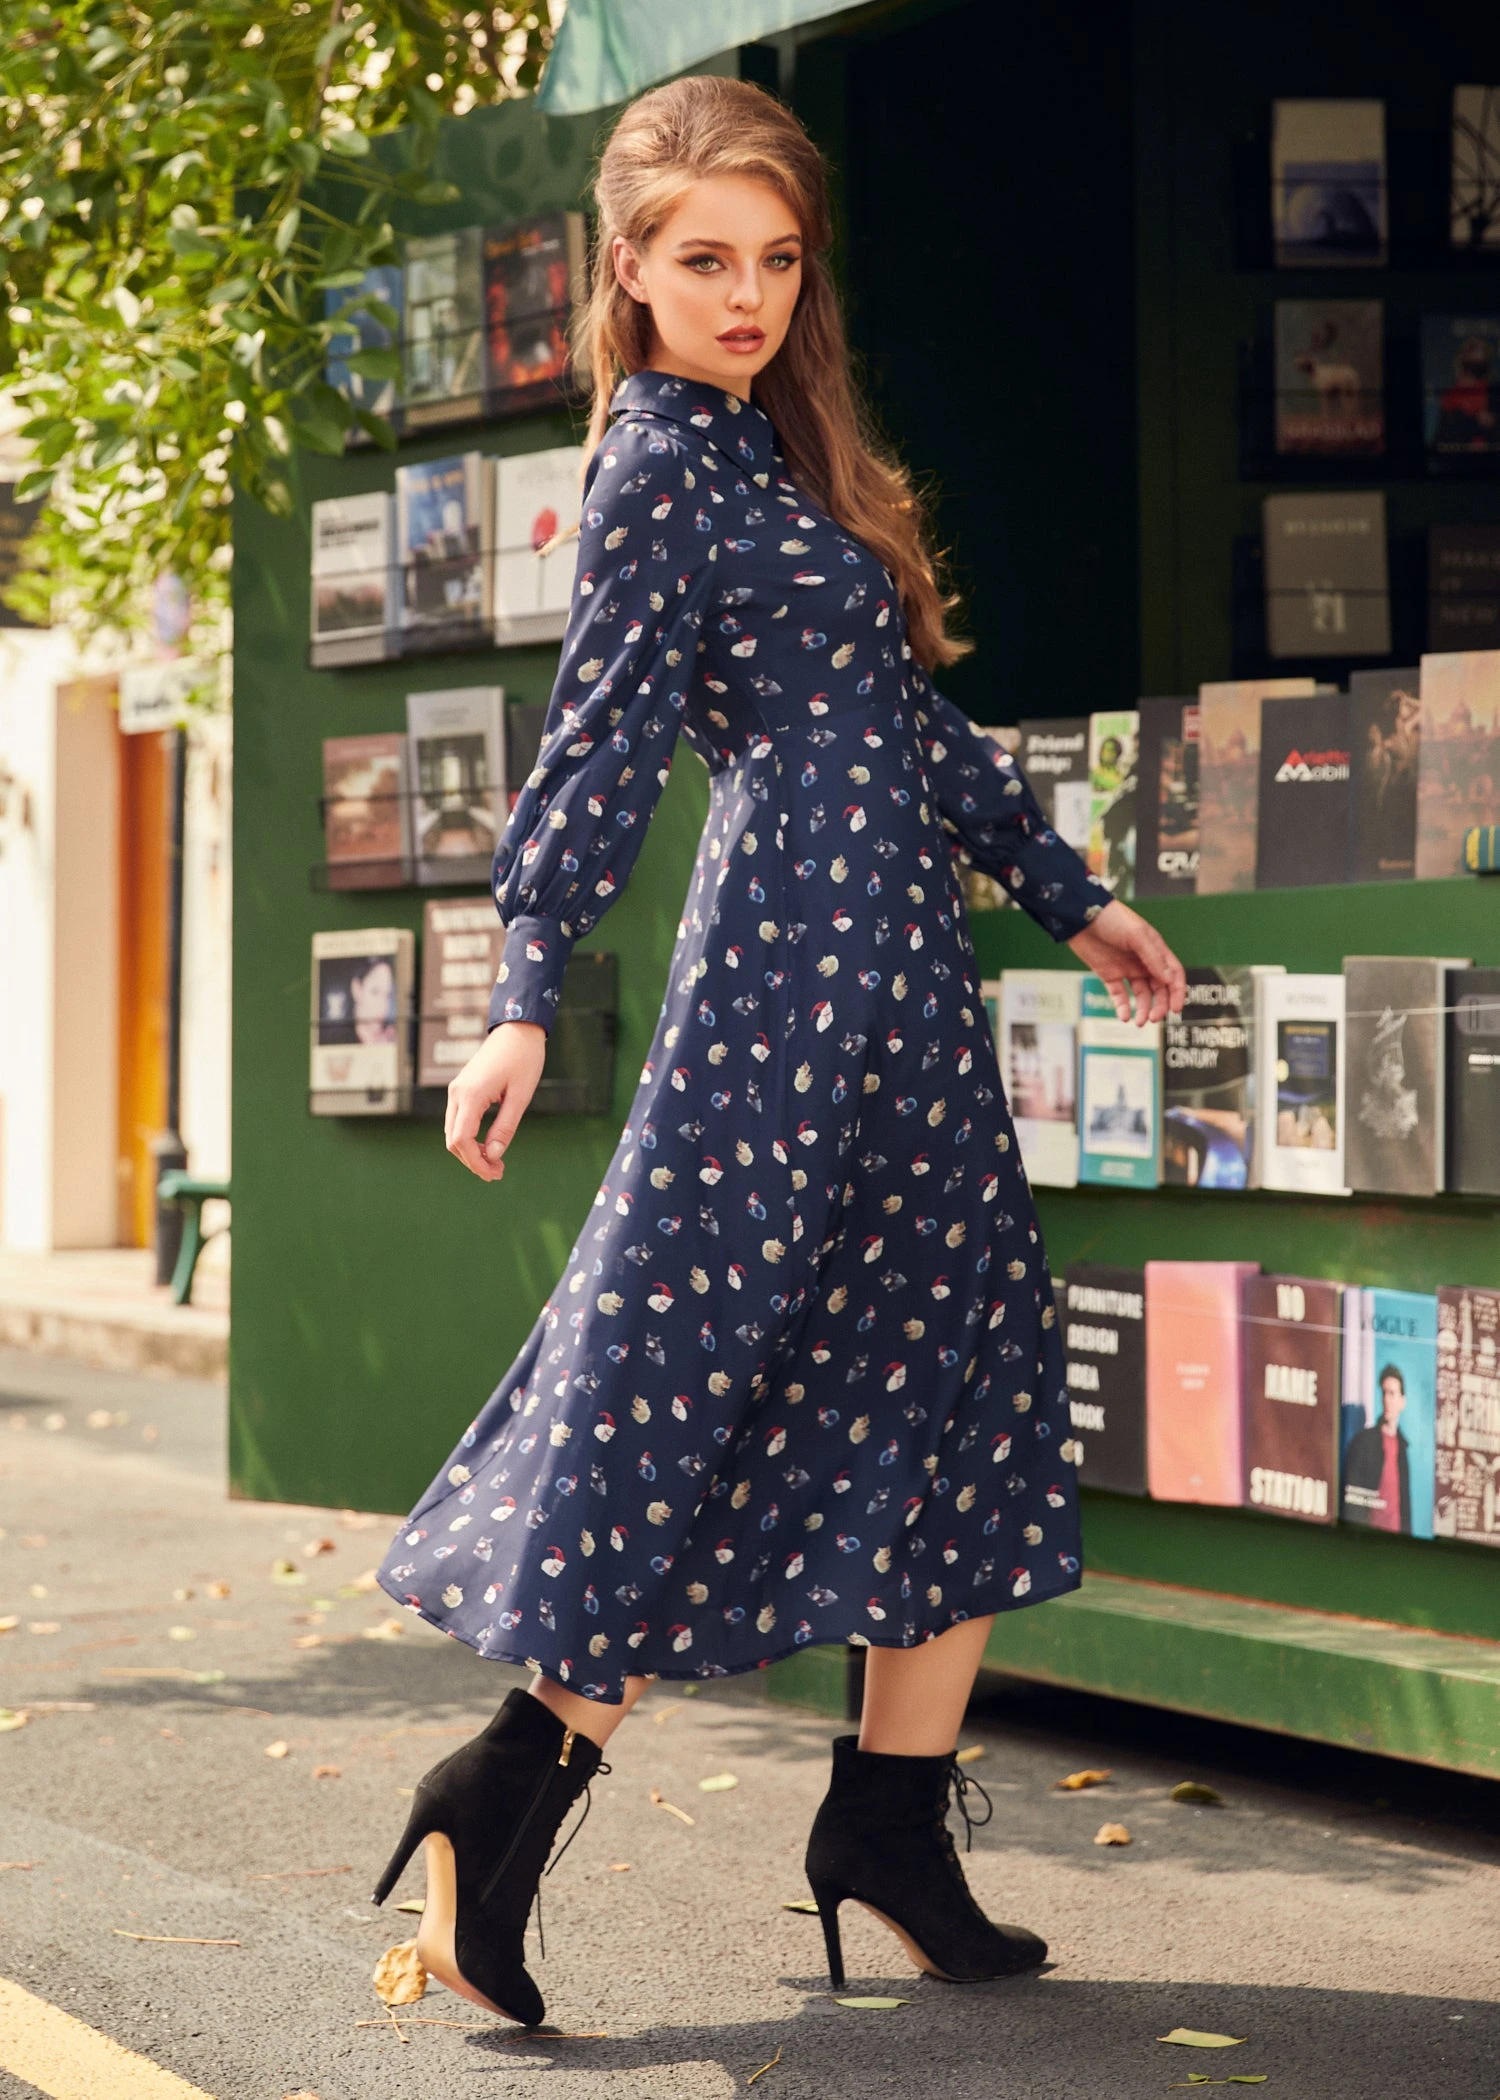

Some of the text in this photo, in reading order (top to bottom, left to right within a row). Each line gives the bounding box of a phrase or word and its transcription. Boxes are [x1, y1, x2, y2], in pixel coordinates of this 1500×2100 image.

[1166, 1025, 1188, 1047] THE
[1165, 1046, 1219, 1068] CENTURY
[1067, 1284, 1144, 1320] FURNITURE
[1276, 1283, 1305, 1322] NO
[1067, 1323, 1119, 1355] DESIGN
[1066, 1362, 1100, 1391] IDEA
[1250, 1466, 1328, 1517] STATION
